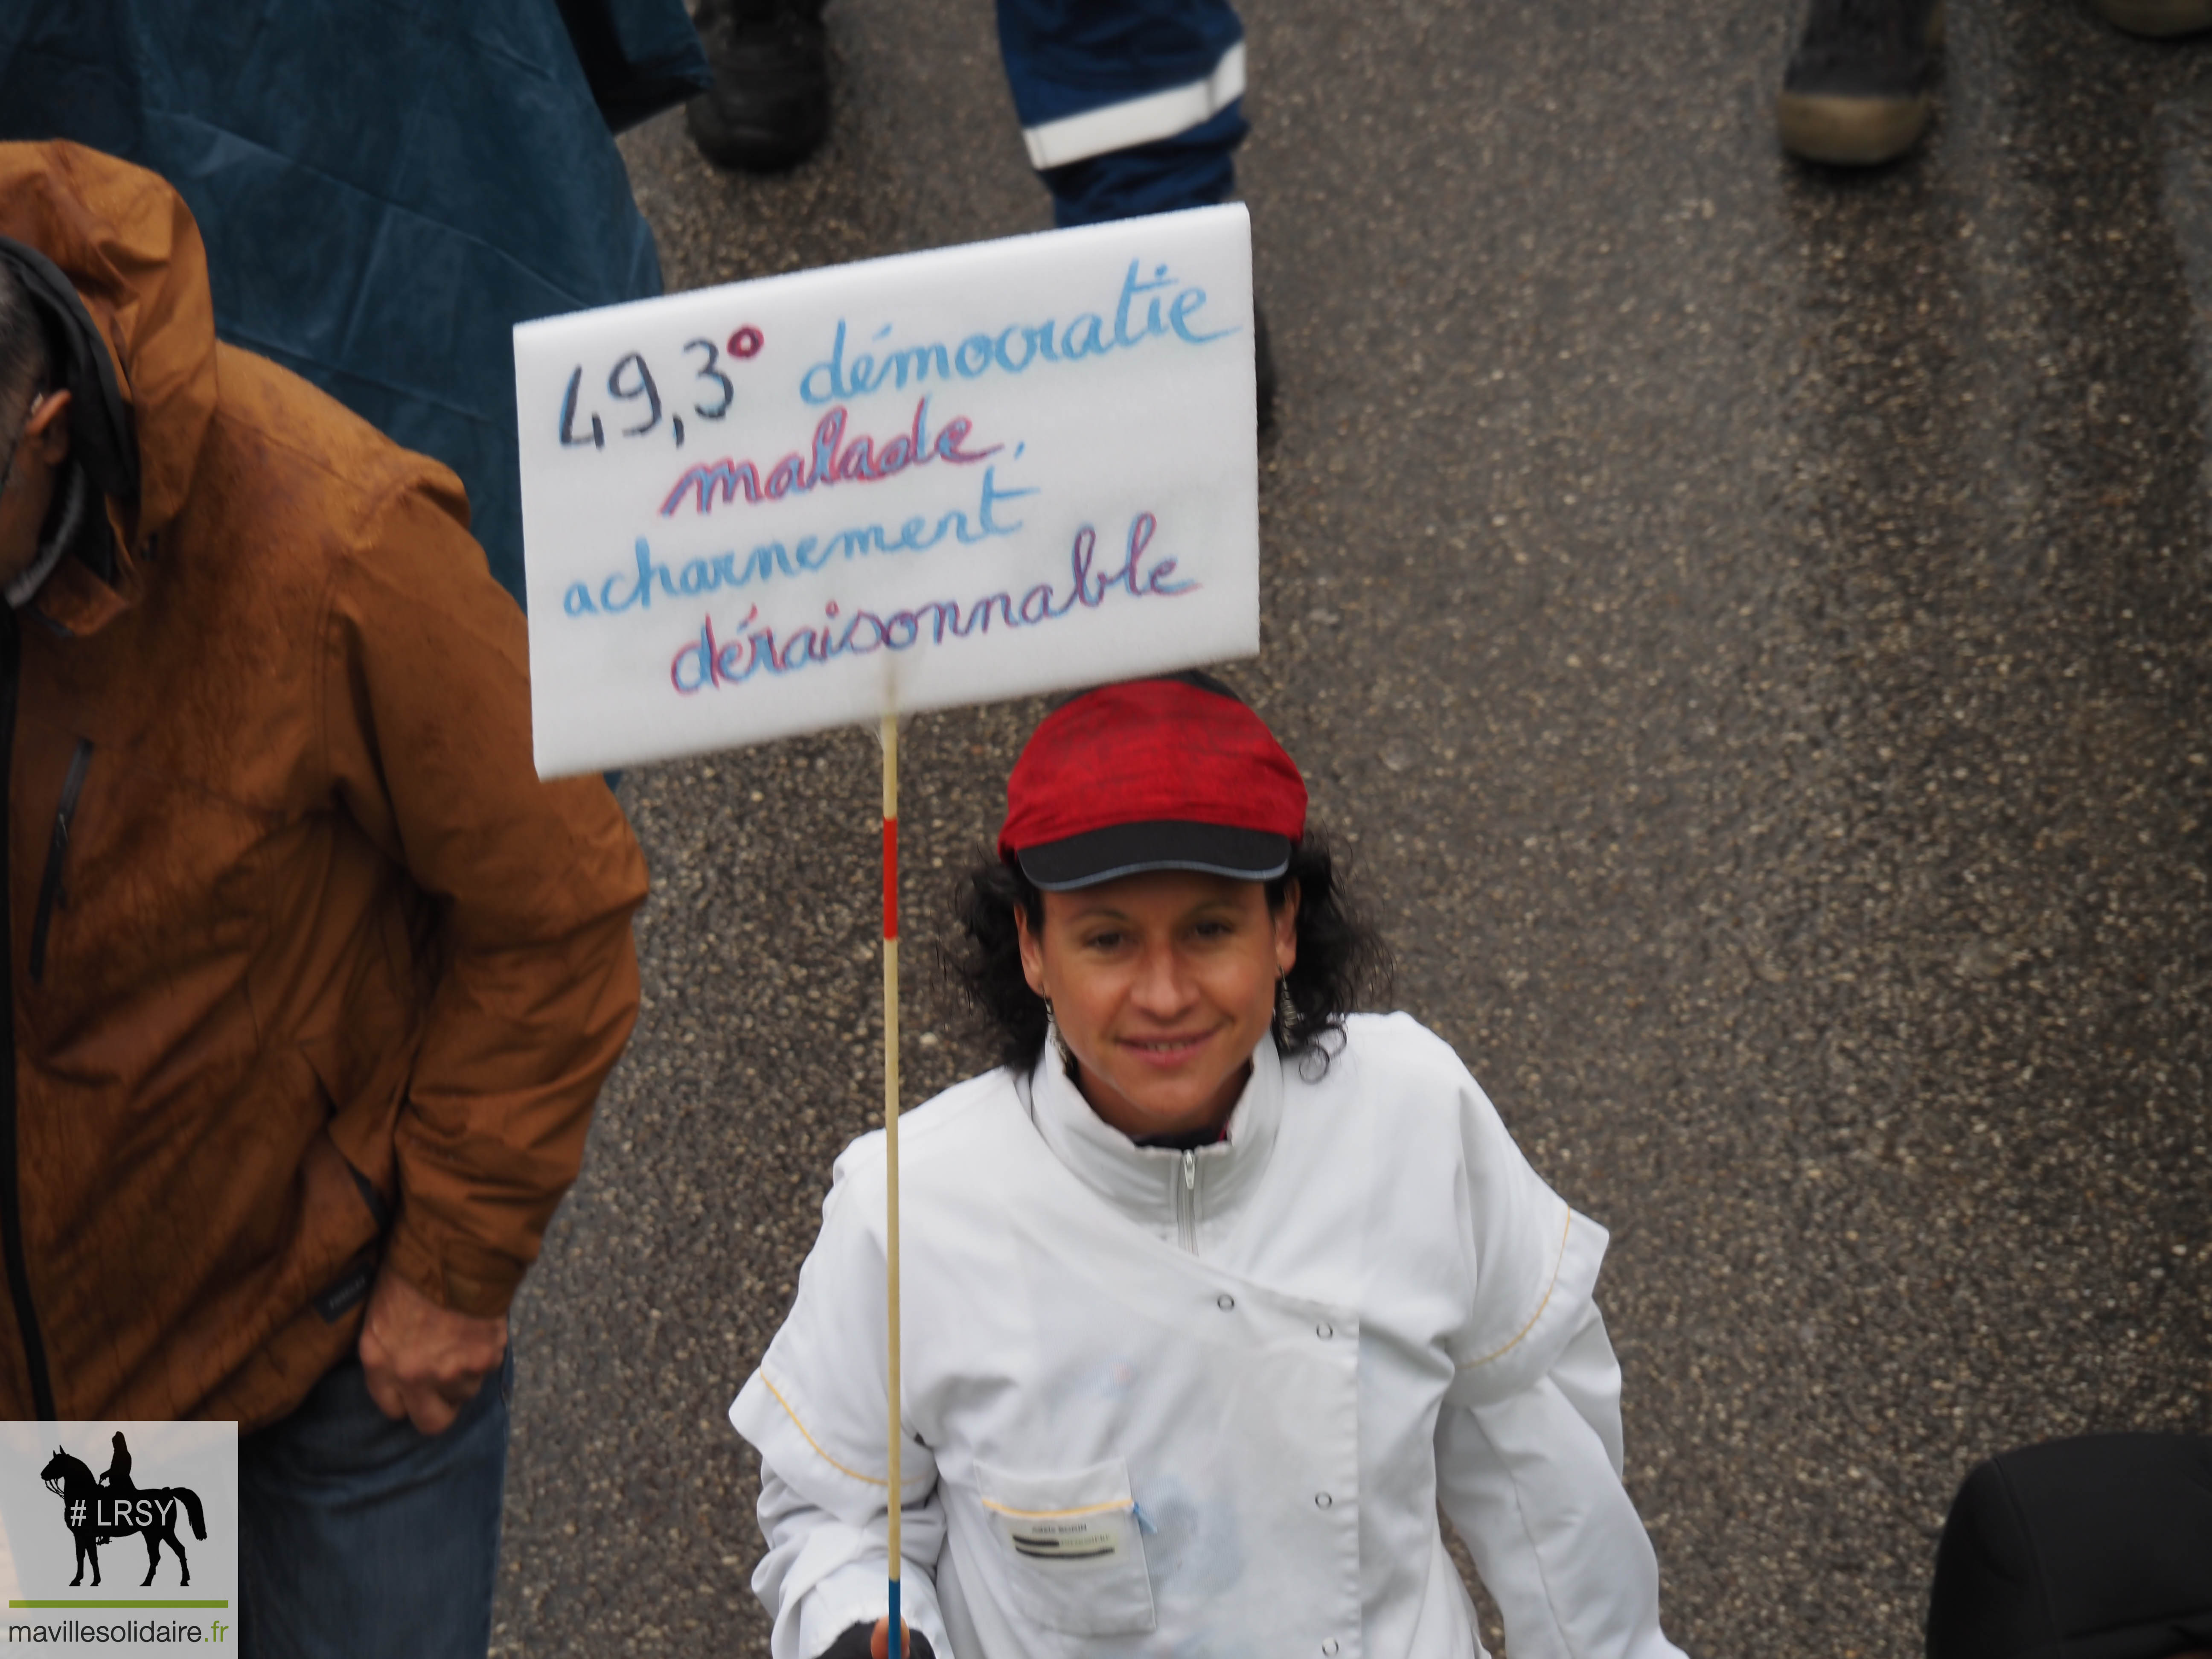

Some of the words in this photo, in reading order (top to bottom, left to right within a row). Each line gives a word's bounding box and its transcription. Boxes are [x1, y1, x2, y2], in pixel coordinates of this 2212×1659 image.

[799, 259, 1240, 405] démocratie
[563, 466, 1039, 617] acharnement
[670, 512, 1201, 694] déraisonnable
